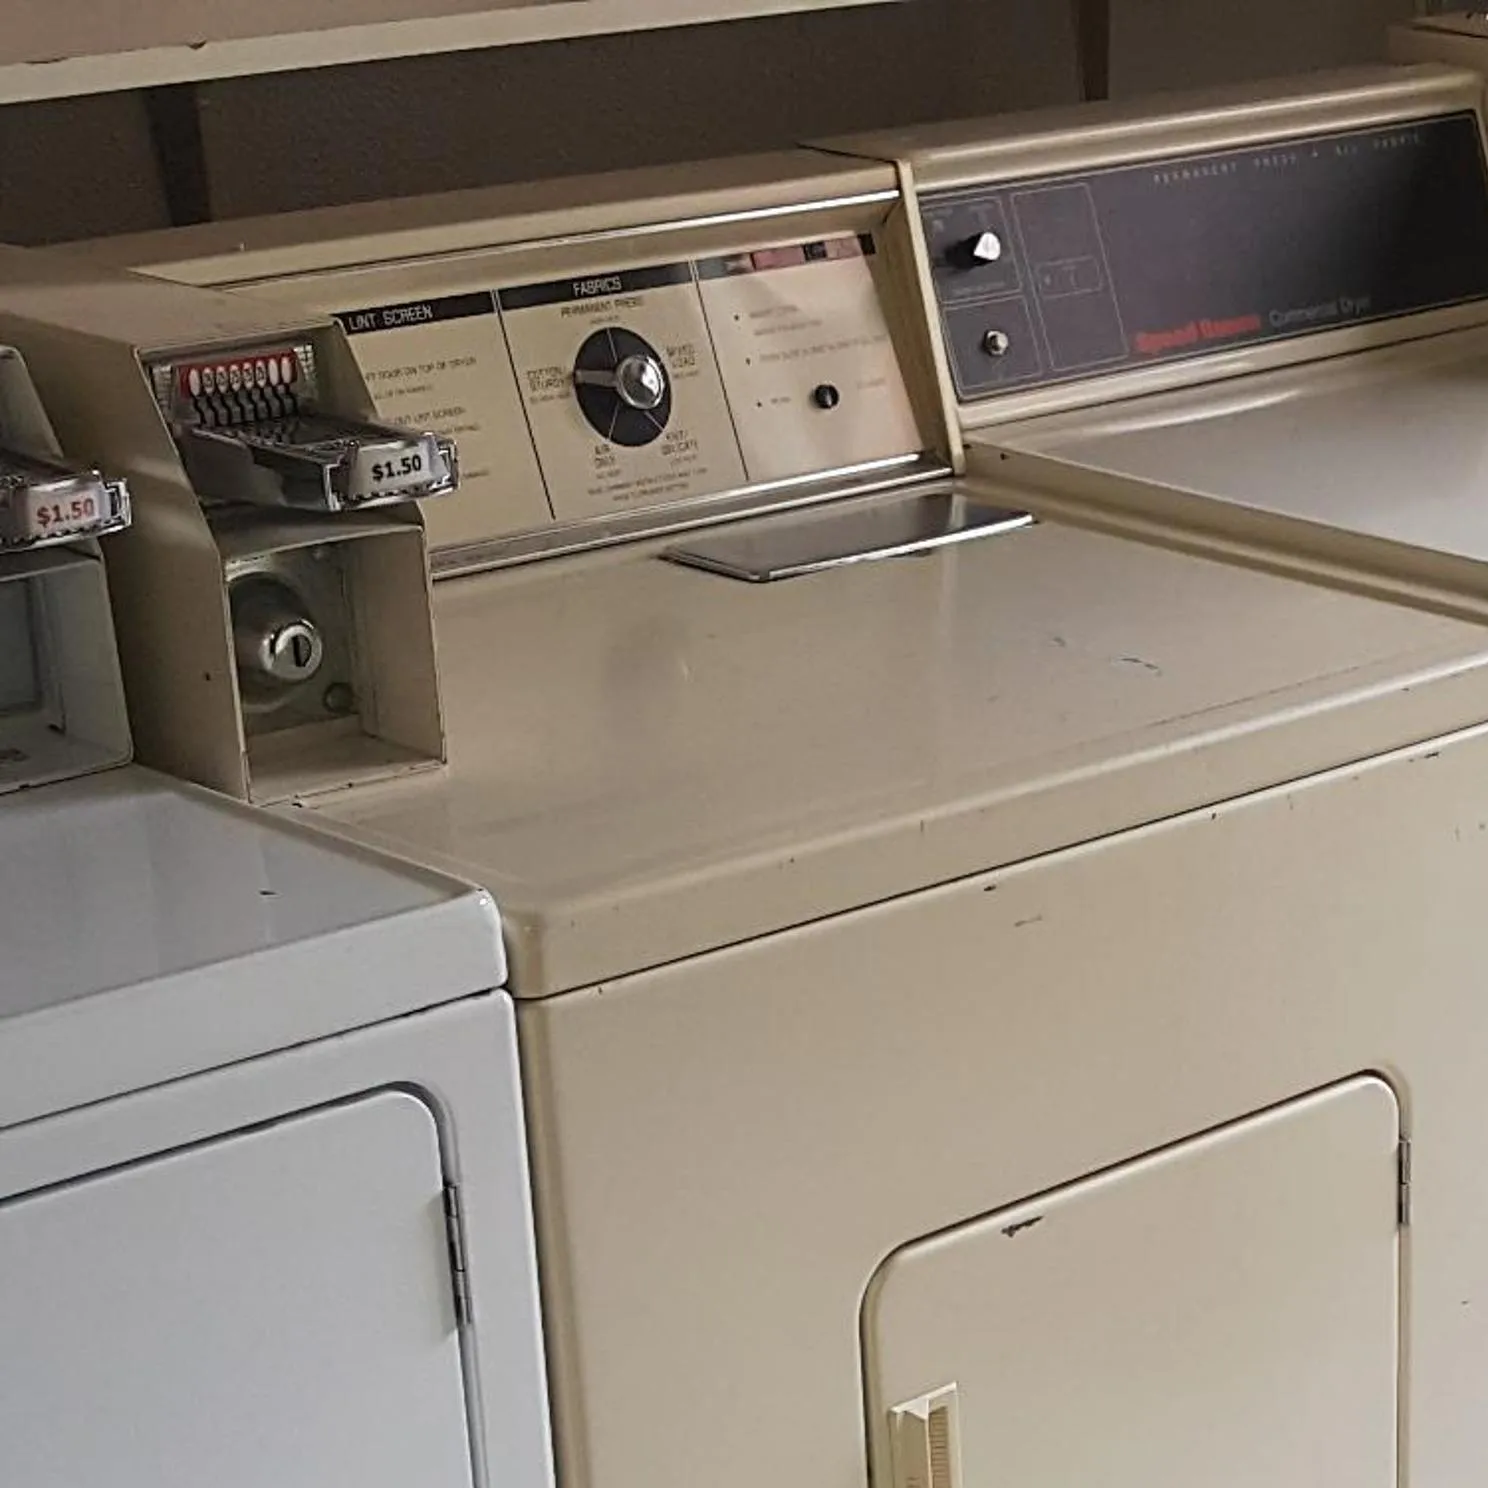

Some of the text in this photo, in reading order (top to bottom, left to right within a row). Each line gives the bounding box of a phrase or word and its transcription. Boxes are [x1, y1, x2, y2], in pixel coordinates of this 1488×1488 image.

[572, 275, 622, 297] FABRICS
[349, 304, 434, 331] LINT SCREEN
[371, 454, 422, 482] $1.50
[36, 498, 95, 529] $1.50
